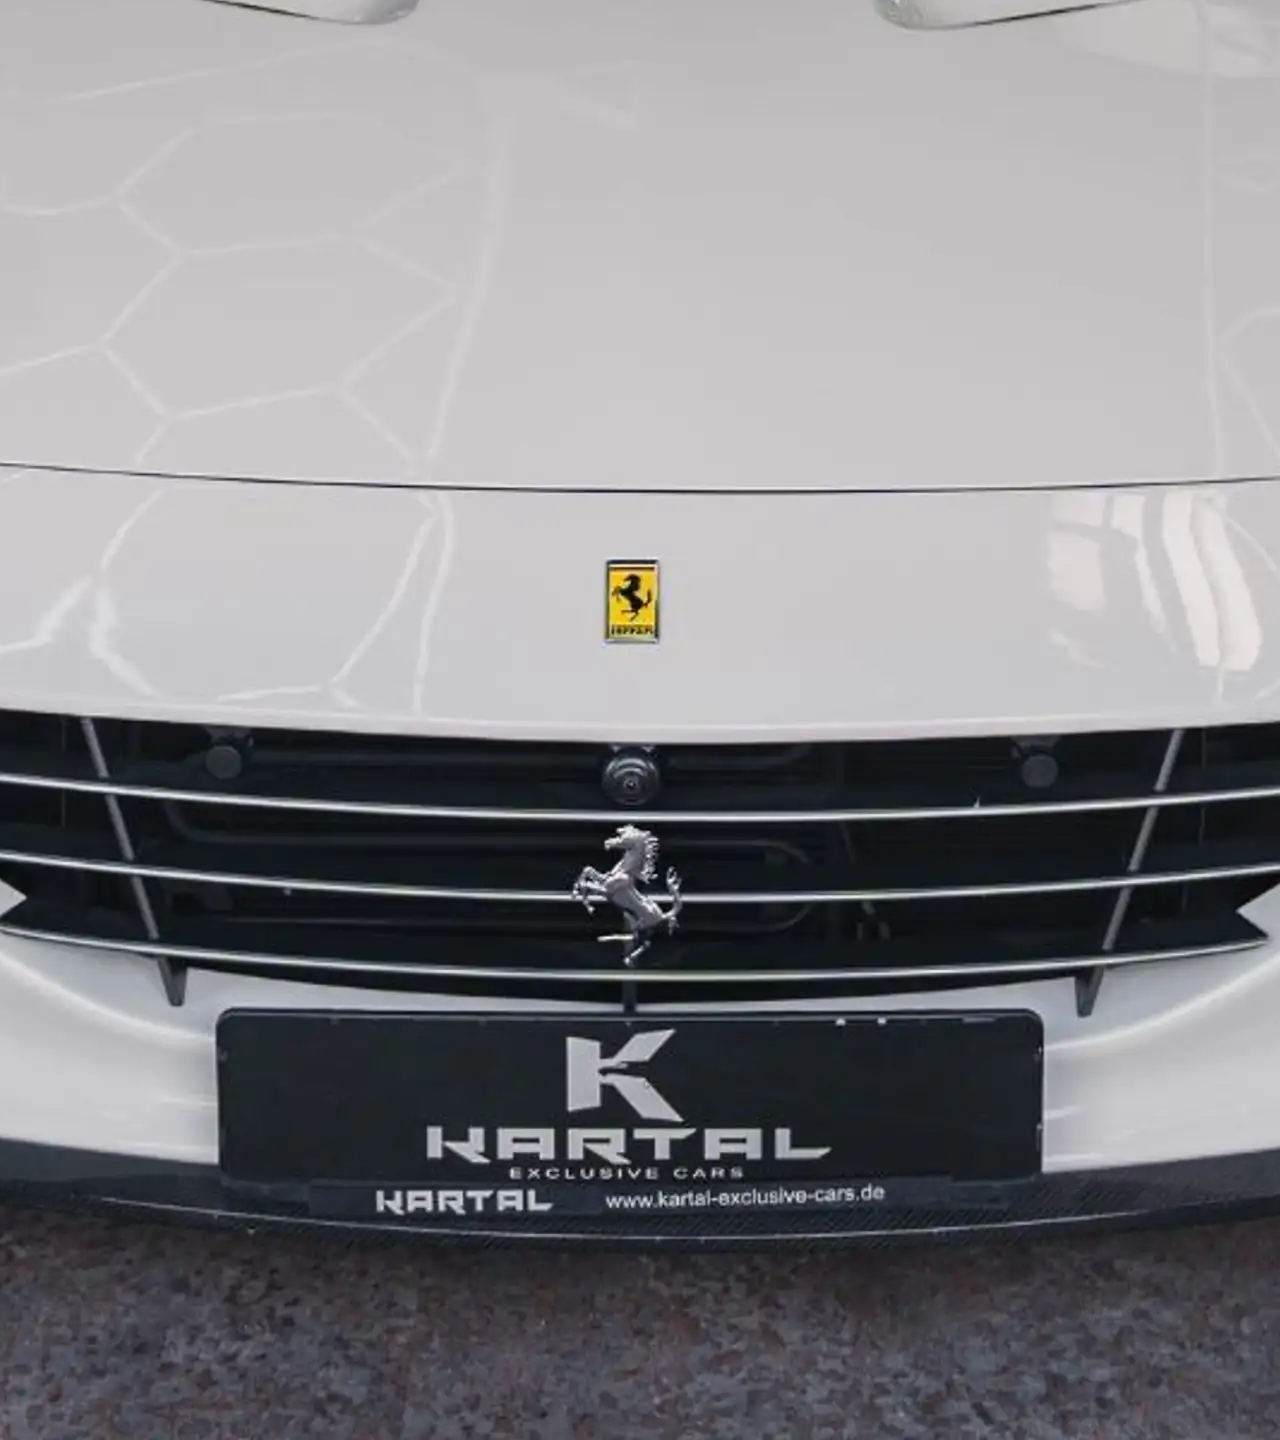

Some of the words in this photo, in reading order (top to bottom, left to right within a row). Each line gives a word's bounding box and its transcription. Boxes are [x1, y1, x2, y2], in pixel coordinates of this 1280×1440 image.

[566, 1028, 684, 1123] K
[426, 1125, 832, 1165] KARTAL
[509, 1166, 660, 1180] EXCLUSIVE
[673, 1166, 744, 1180] CARS
[375, 1188, 554, 1216] KARTAL
[605, 1182, 886, 1210] www.kartal-exclusive-cars.de
